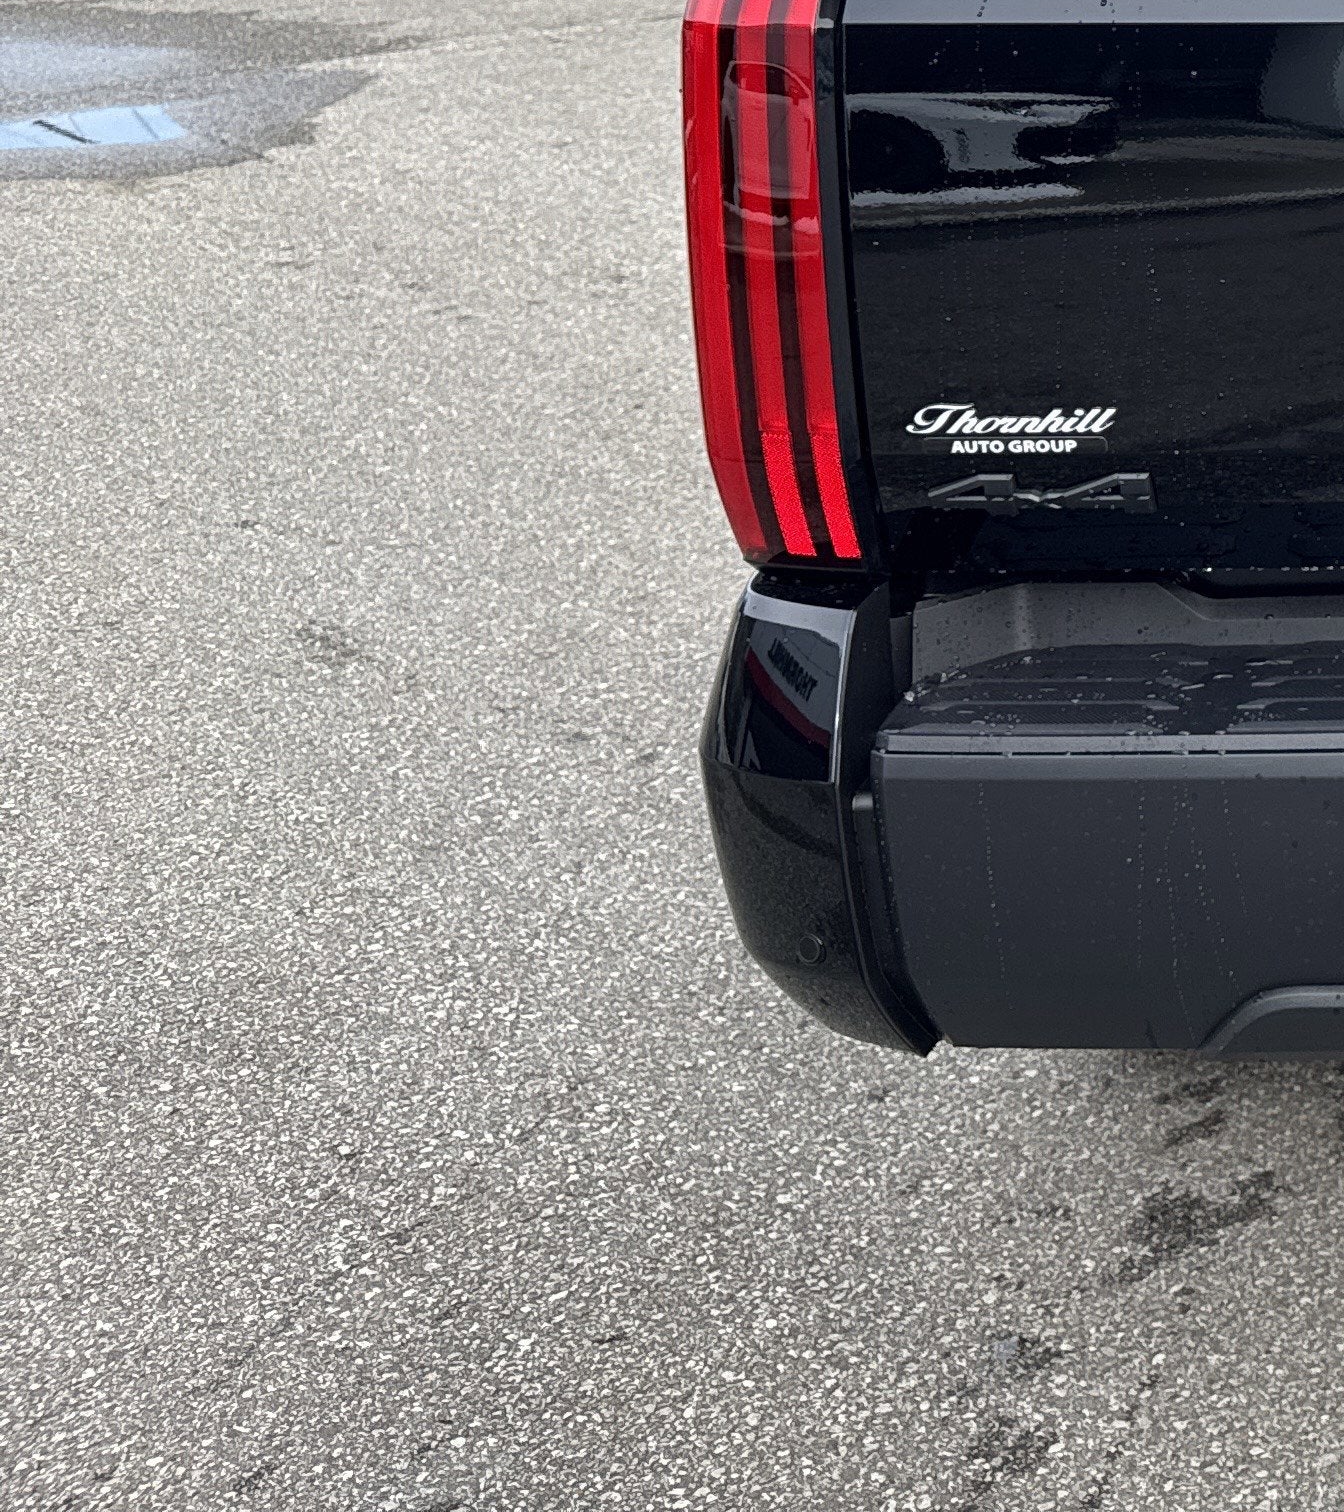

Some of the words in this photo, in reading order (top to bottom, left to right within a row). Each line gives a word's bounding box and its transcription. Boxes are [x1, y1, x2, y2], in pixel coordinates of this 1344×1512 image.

[905, 402, 1117, 435] Thornhill
[951, 439, 1005, 454] AUTO
[1007, 439, 1078, 454] GROUP
